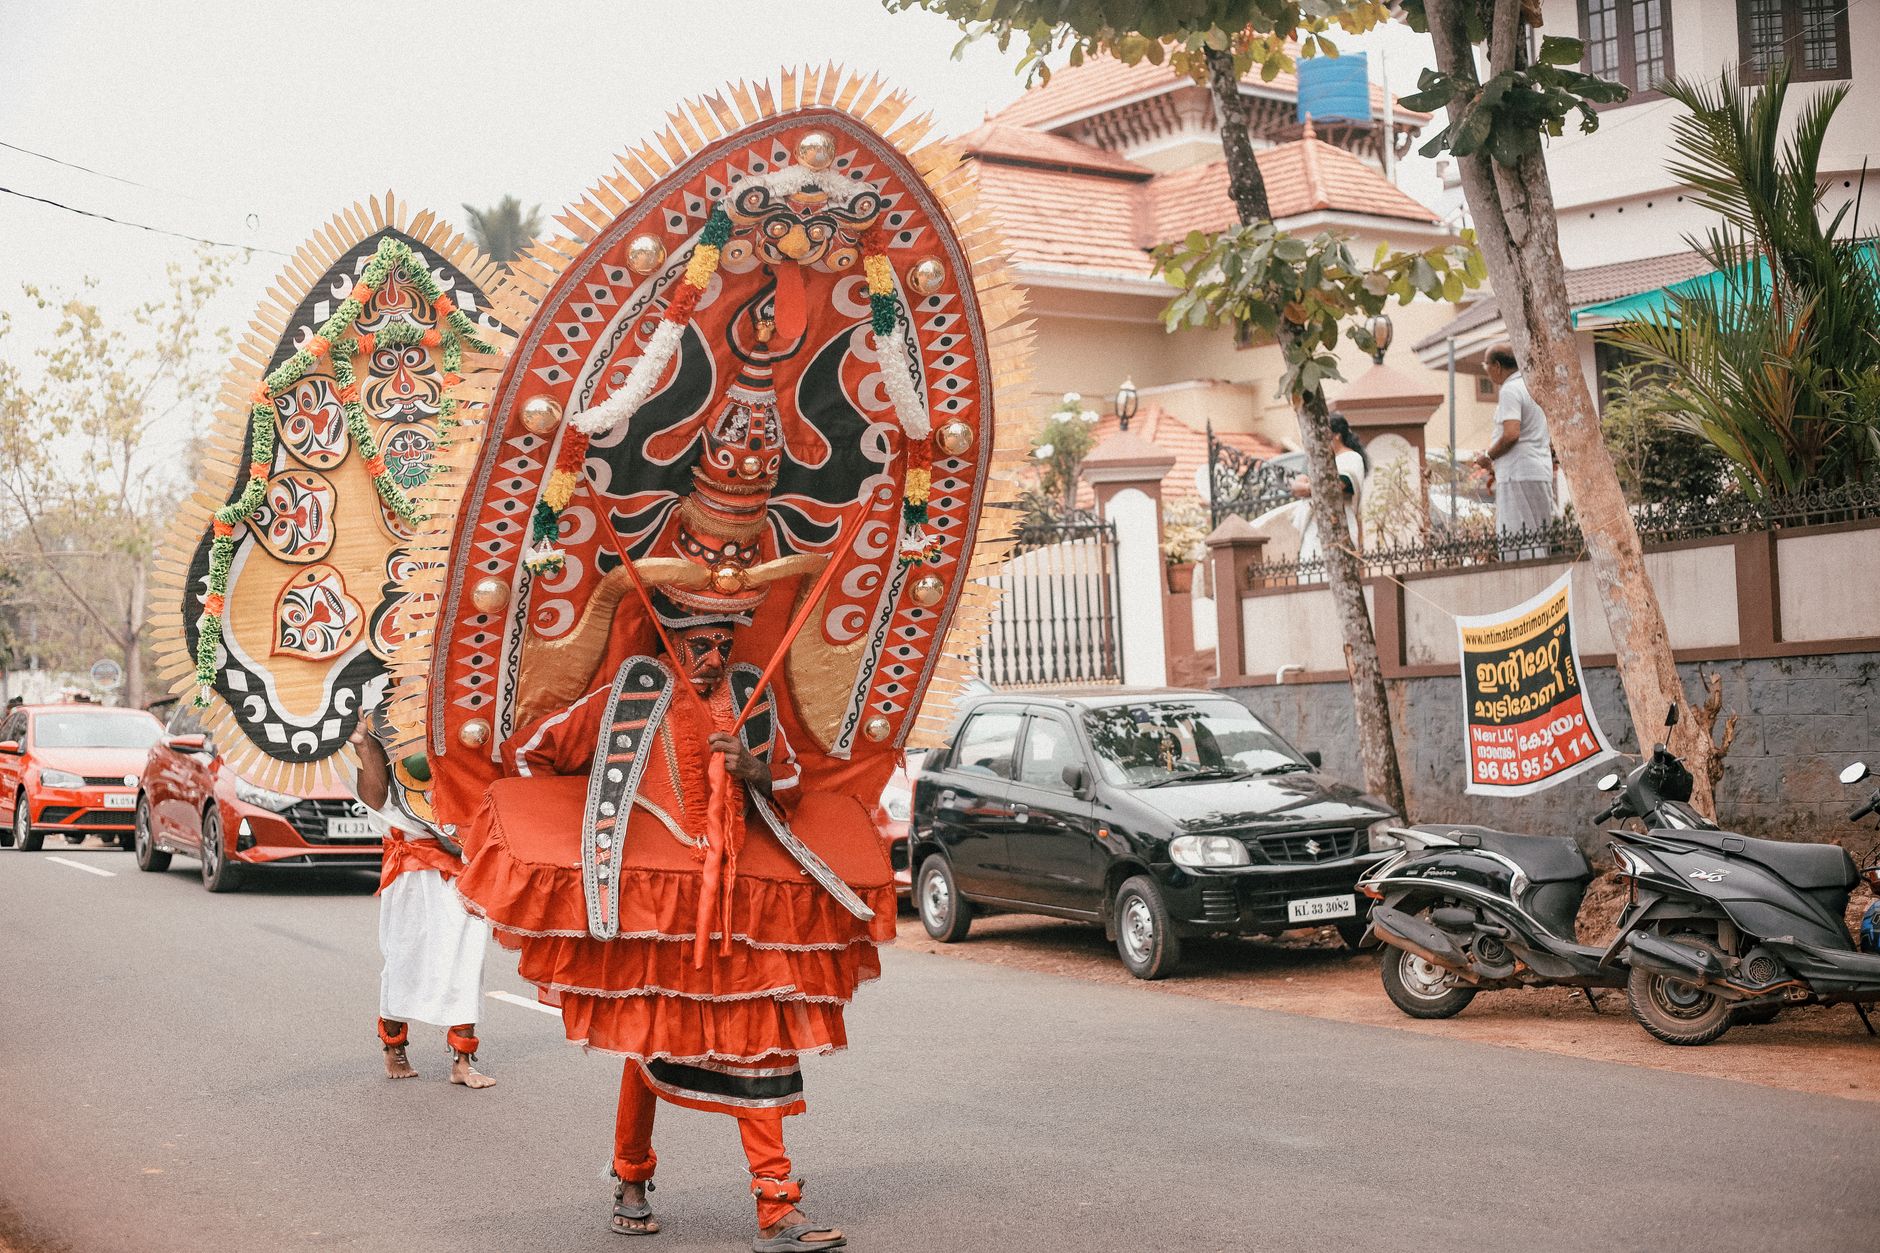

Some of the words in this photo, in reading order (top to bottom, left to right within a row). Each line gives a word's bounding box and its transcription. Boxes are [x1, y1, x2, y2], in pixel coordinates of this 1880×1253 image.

[1465, 596, 1566, 645] www.intimatematrimony.com
[1474, 670, 1565, 724] മാട്രിമോണി
[1473, 728, 1496, 742] Near
[1497, 728, 1514, 743] LIC
[1478, 760, 1499, 780] 96
[1501, 761, 1519, 780] 45
[1521, 756, 1541, 779] 95
[337, 822, 350, 833] KL
[353, 822, 365, 834] 33
[1295, 904, 1309, 917] KL
[1311, 902, 1324, 915] 33
[1326, 900, 1349, 913] 3082
